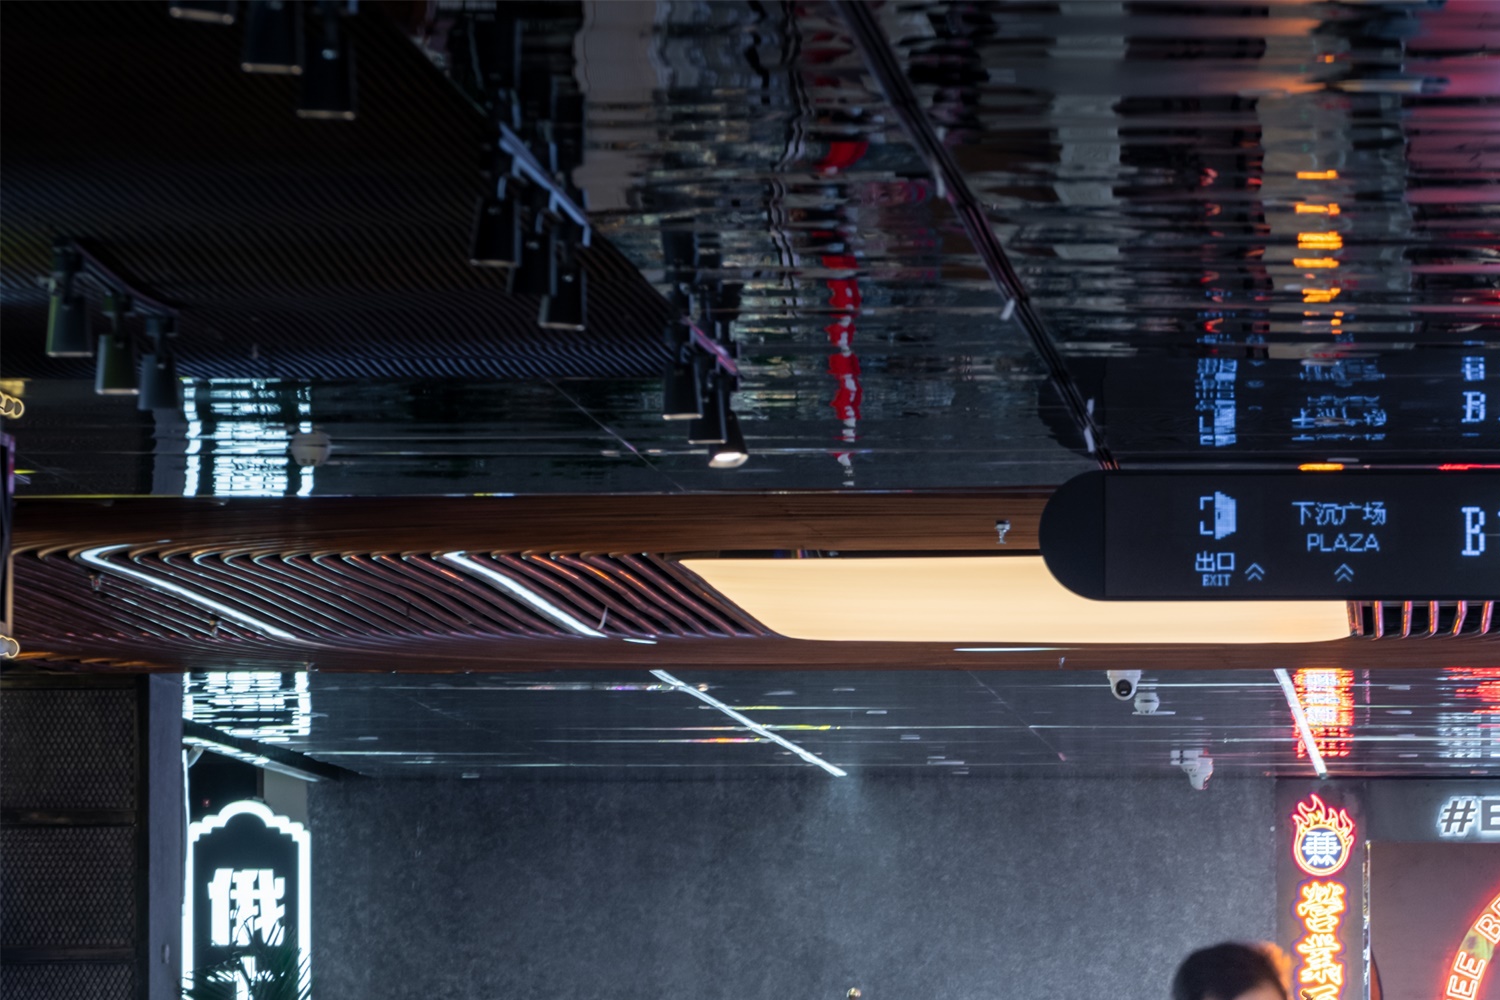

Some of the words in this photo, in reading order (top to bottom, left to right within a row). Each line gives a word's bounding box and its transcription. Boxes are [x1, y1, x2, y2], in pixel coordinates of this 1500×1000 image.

[1292, 501, 1386, 526] 下沉广场
[1307, 533, 1380, 553] PLAZA
[1195, 551, 1235, 572] 出口
[1202, 574, 1231, 587] EXIT
